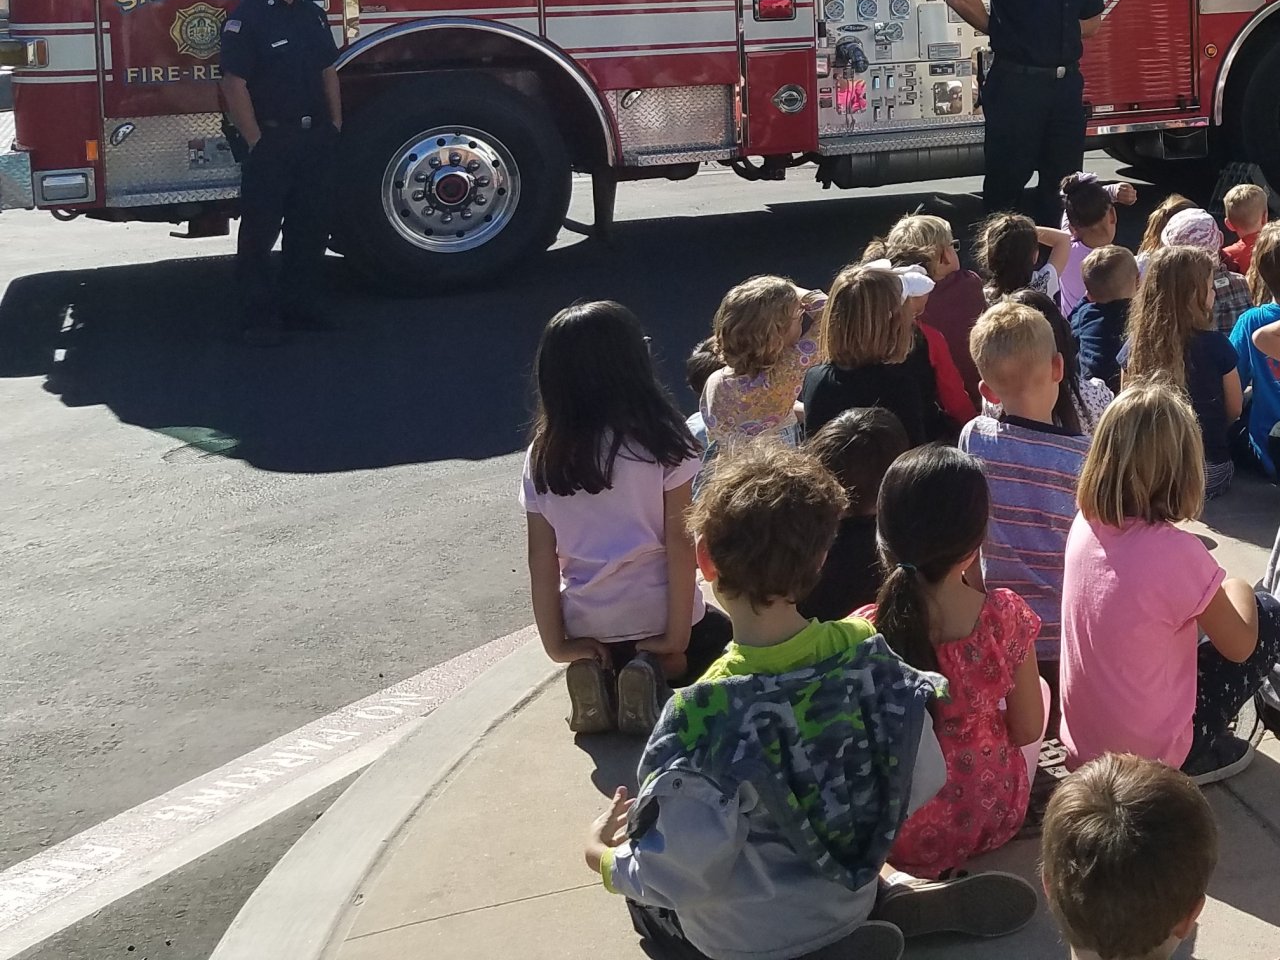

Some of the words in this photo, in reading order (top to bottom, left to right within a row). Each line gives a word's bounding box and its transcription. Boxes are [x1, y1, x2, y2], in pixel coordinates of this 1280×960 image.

[126, 64, 223, 83] FIRE-RE
[356, 690, 438, 721] NO
[151, 724, 364, 824] PARKING
